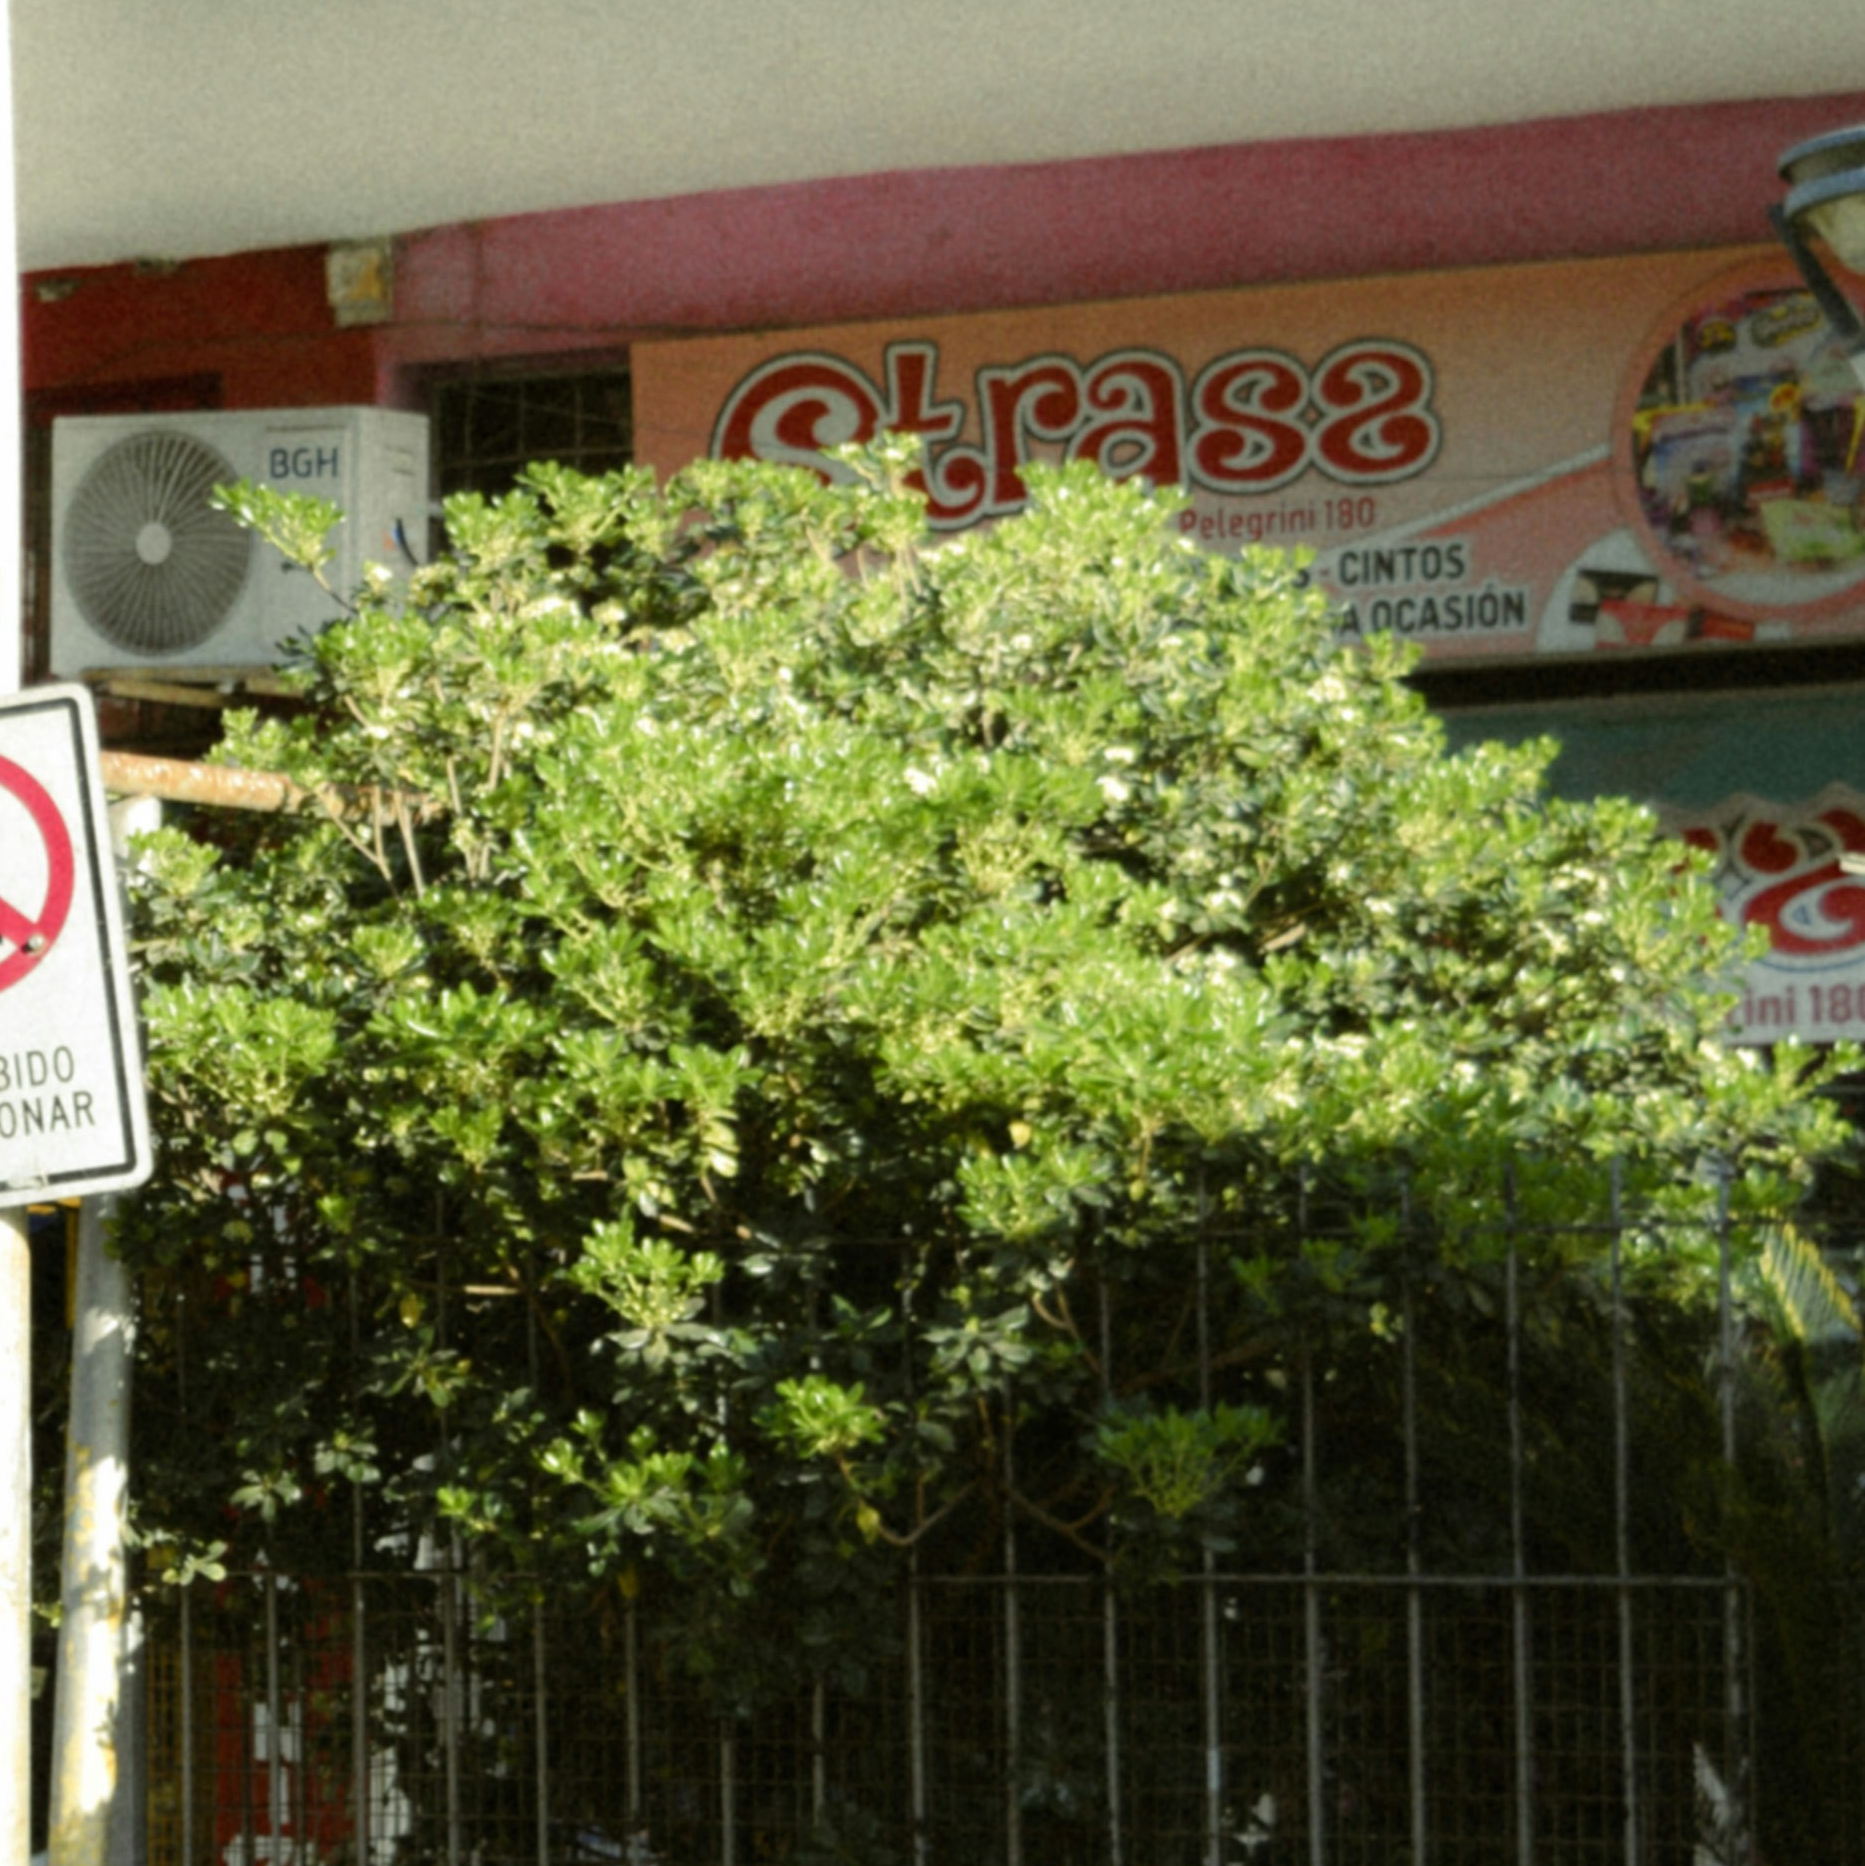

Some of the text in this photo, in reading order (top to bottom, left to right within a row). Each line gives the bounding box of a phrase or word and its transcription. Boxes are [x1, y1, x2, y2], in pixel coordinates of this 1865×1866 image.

[712, 341, 1437, 530] Strass
[269, 447, 339, 479] BGH
[1179, 496, 1376, 541] Pelegrini 180
[1338, 543, 1466, 587] CINTOS
[1370, 583, 1525, 634] OCASIÓN
